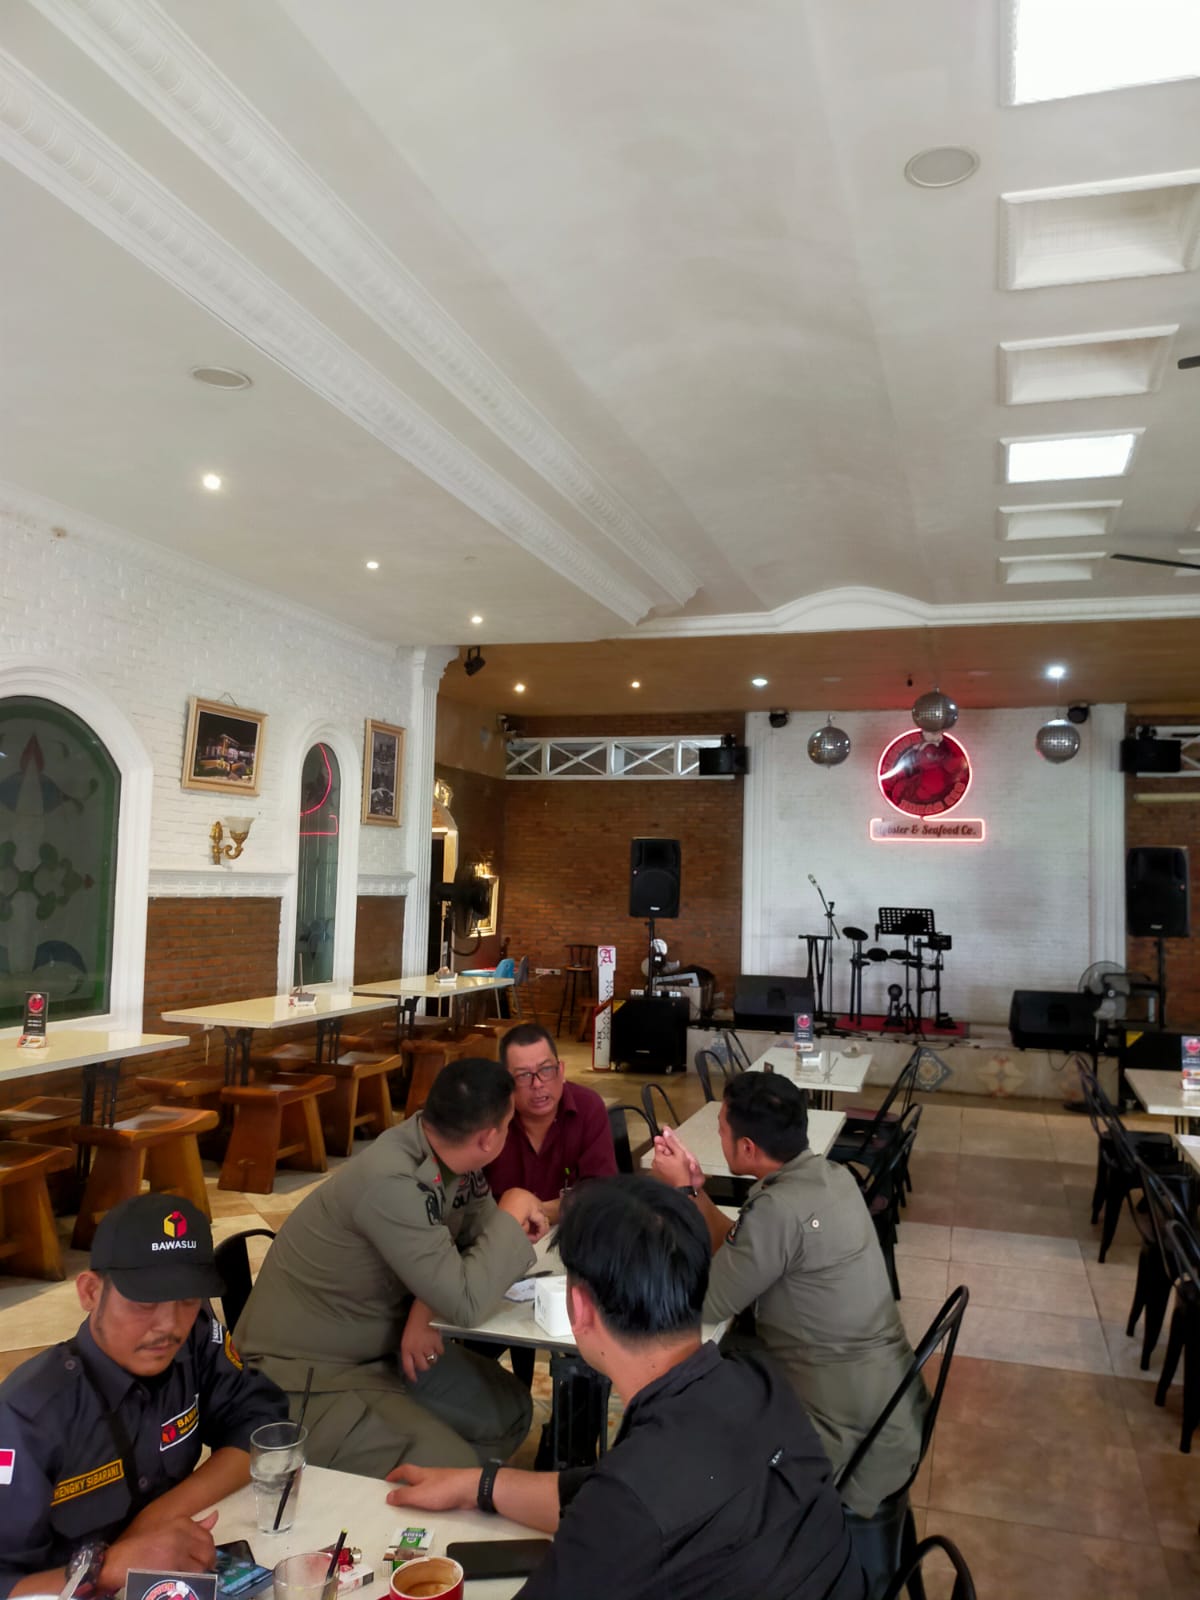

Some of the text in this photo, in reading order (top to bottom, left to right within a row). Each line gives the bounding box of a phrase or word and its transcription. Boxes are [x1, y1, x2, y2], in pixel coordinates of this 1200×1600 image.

[911, 824, 920, 835] &
[922, 824, 960, 838] Seafood
[151, 1240, 197, 1251] BAWASLU
